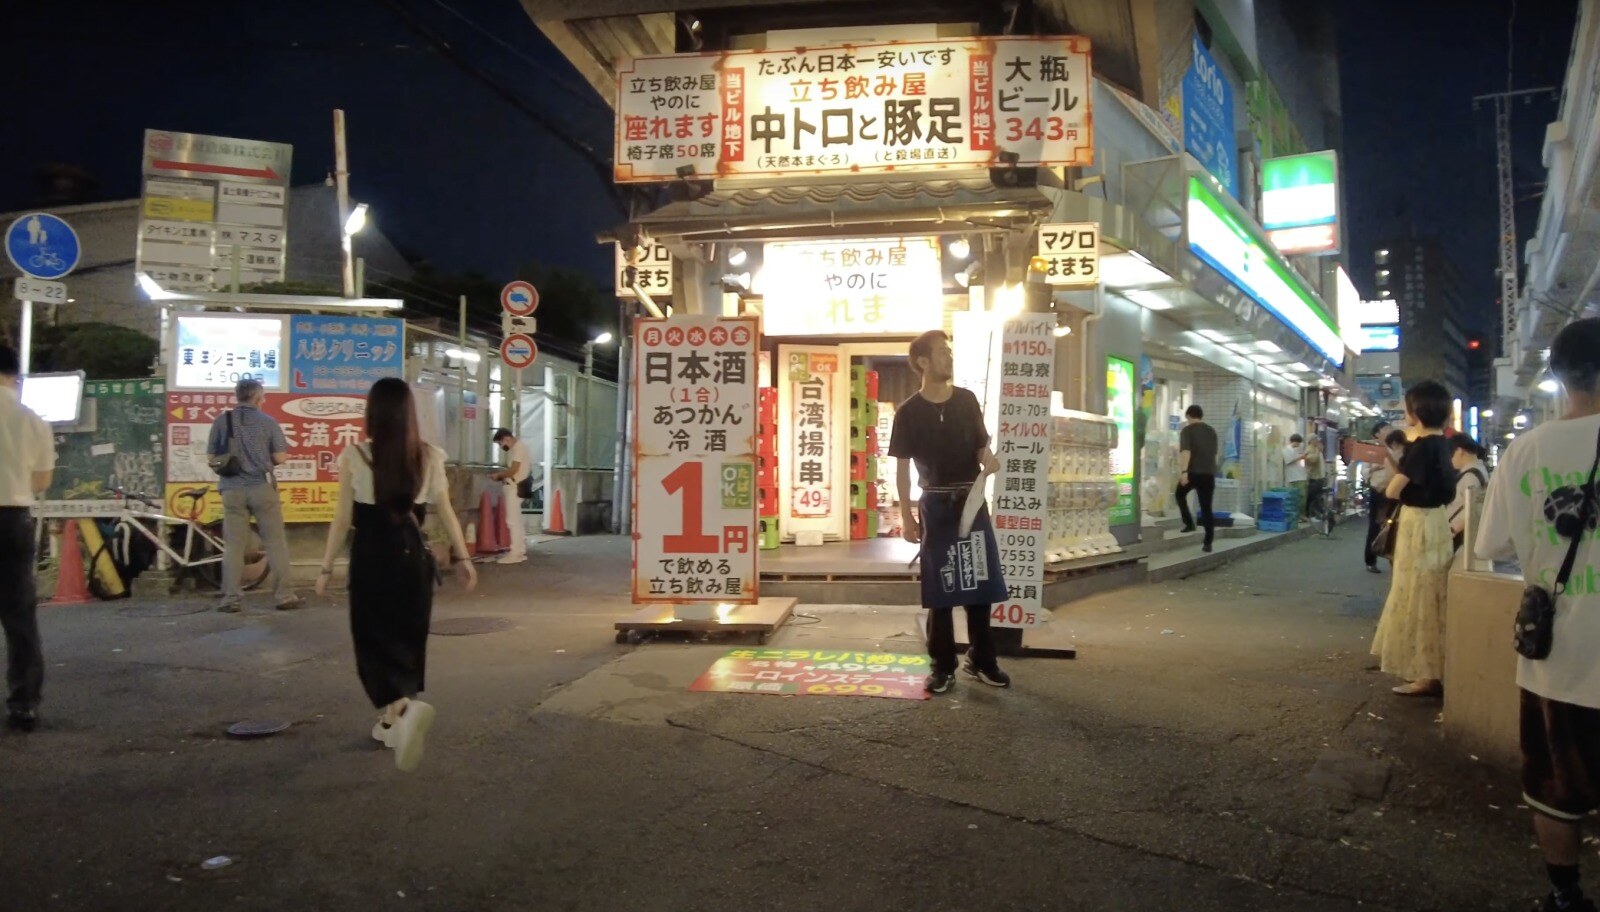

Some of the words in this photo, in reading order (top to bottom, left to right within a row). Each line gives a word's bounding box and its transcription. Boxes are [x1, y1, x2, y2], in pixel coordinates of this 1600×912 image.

[758, 48, 956, 76] たぶん日本一安いです
[1005, 55, 1069, 82] 大瓶
[630, 74, 716, 93] 立ち飲み屋
[789, 72, 928, 102] 立ち飲み屋
[651, 95, 700, 110] やのに
[973, 60, 990, 146] 当ビル地下
[998, 86, 1078, 112] ビール
[725, 73, 741, 157] 当ビル地下
[624, 112, 719, 140] 座れます
[750, 97, 964, 154] 中トロと豚足
[1006, 116, 1078, 141] 343円
[627, 143, 716, 160] 椅子席50席
[1042, 230, 1095, 250] マグロ
[620, 269, 669, 288] まち
[823, 272, 888, 292] やのに
[645, 328, 749, 345] 月火水木金
[646, 350, 746, 384] 日本酒
[1003, 362, 1050, 378] 独身寮
[670, 387, 719, 403] (1合)
[1002, 382, 1050, 399] 現金日払
[653, 404, 742, 425] あつかん
[798, 374, 826, 485] 台湾揚串
[1000, 421, 1048, 437] ネイルOK
[668, 429, 727, 452] 冷酒
[1001, 440, 1044, 454] ホール
[1006, 459, 1037, 474] 接客
[1005, 477, 1036, 492] 調理
[661, 462, 748, 553] 1円
[996, 495, 1042, 510] 仕込み
[1007, 535, 1035, 547] 090
[1001, 549, 1035, 562] 7553
[659, 557, 731, 575] で飲める
[649, 577, 742, 595] 立ち飲み屋
[1007, 585, 1037, 600] 社員
[991, 603, 1036, 625] 40万
